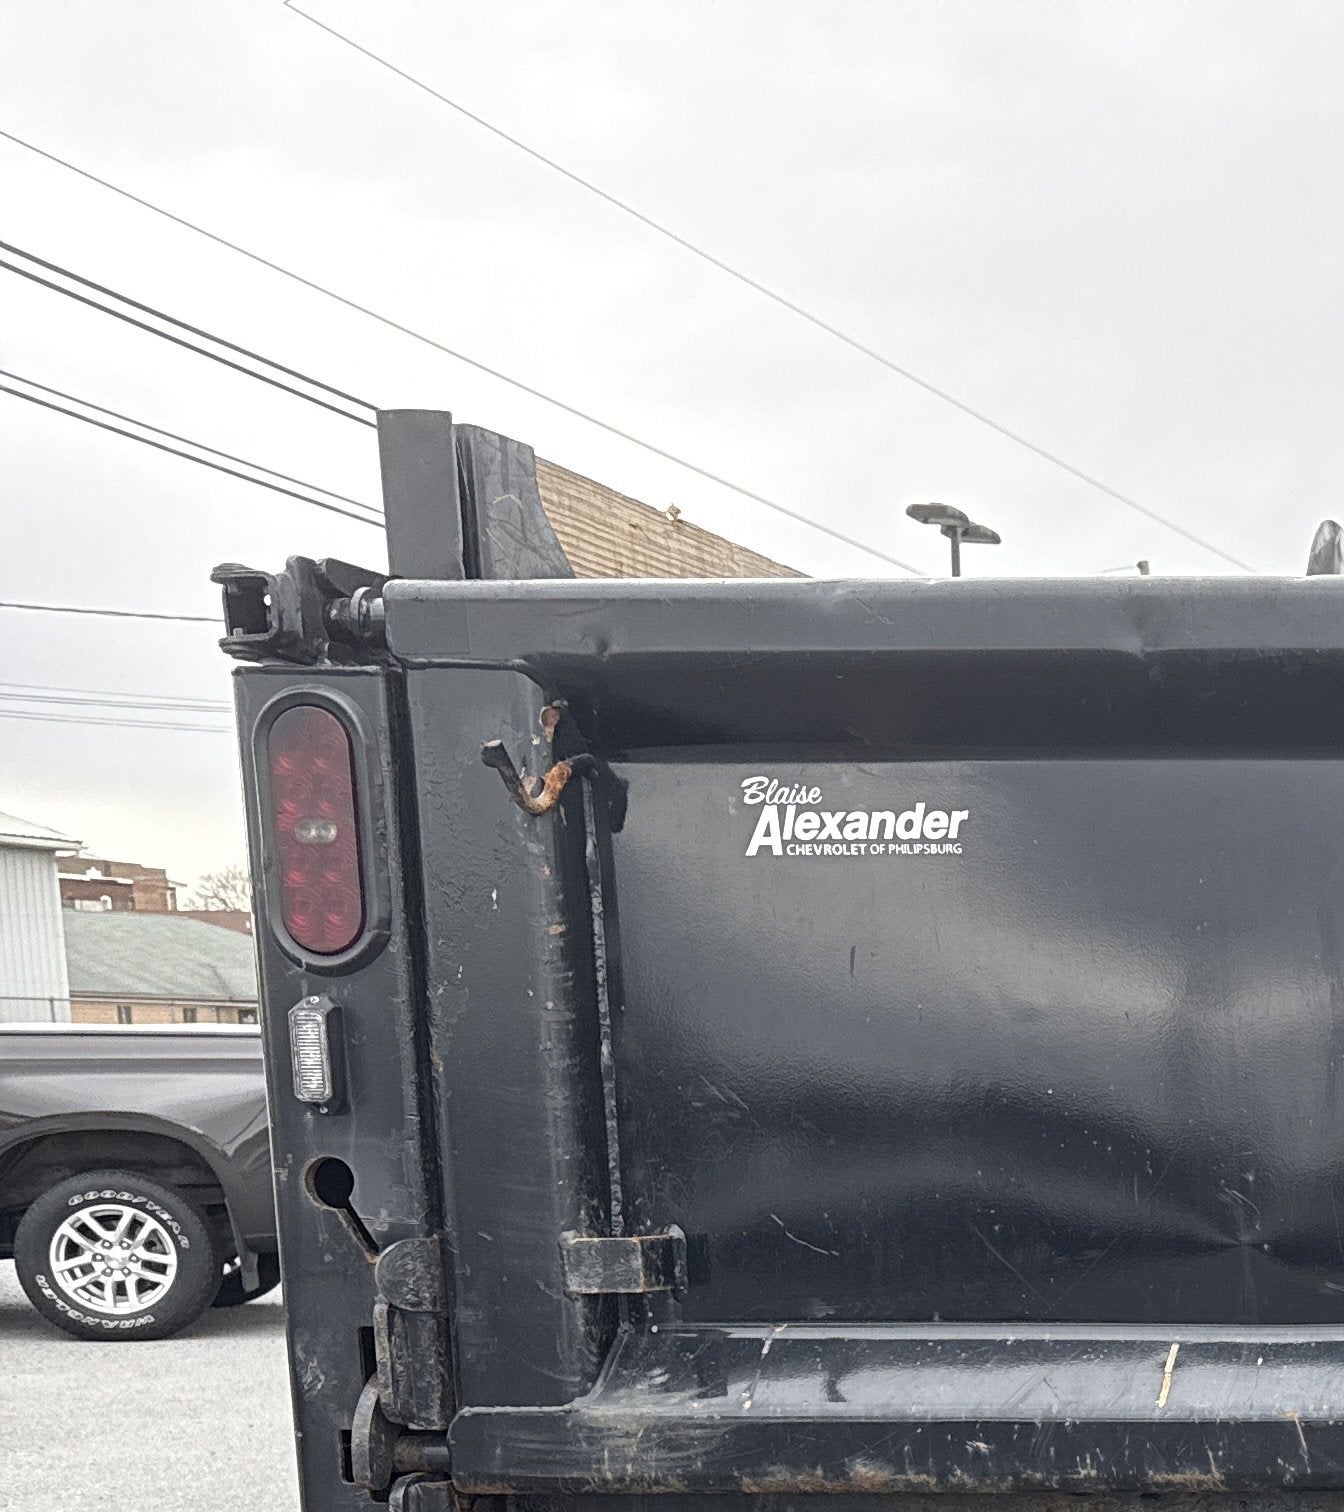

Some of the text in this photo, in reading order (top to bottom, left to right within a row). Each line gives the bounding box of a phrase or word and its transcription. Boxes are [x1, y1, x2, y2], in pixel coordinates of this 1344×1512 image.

[740, 776, 823, 805] Blaise
[745, 802, 970, 857] Alexander
[786, 843, 963, 856] CHEVROLET OF PHILIPSBURG
[68, 1189, 190, 1249] GOODYEAR
[36, 1274, 155, 1329] WRANGLER
